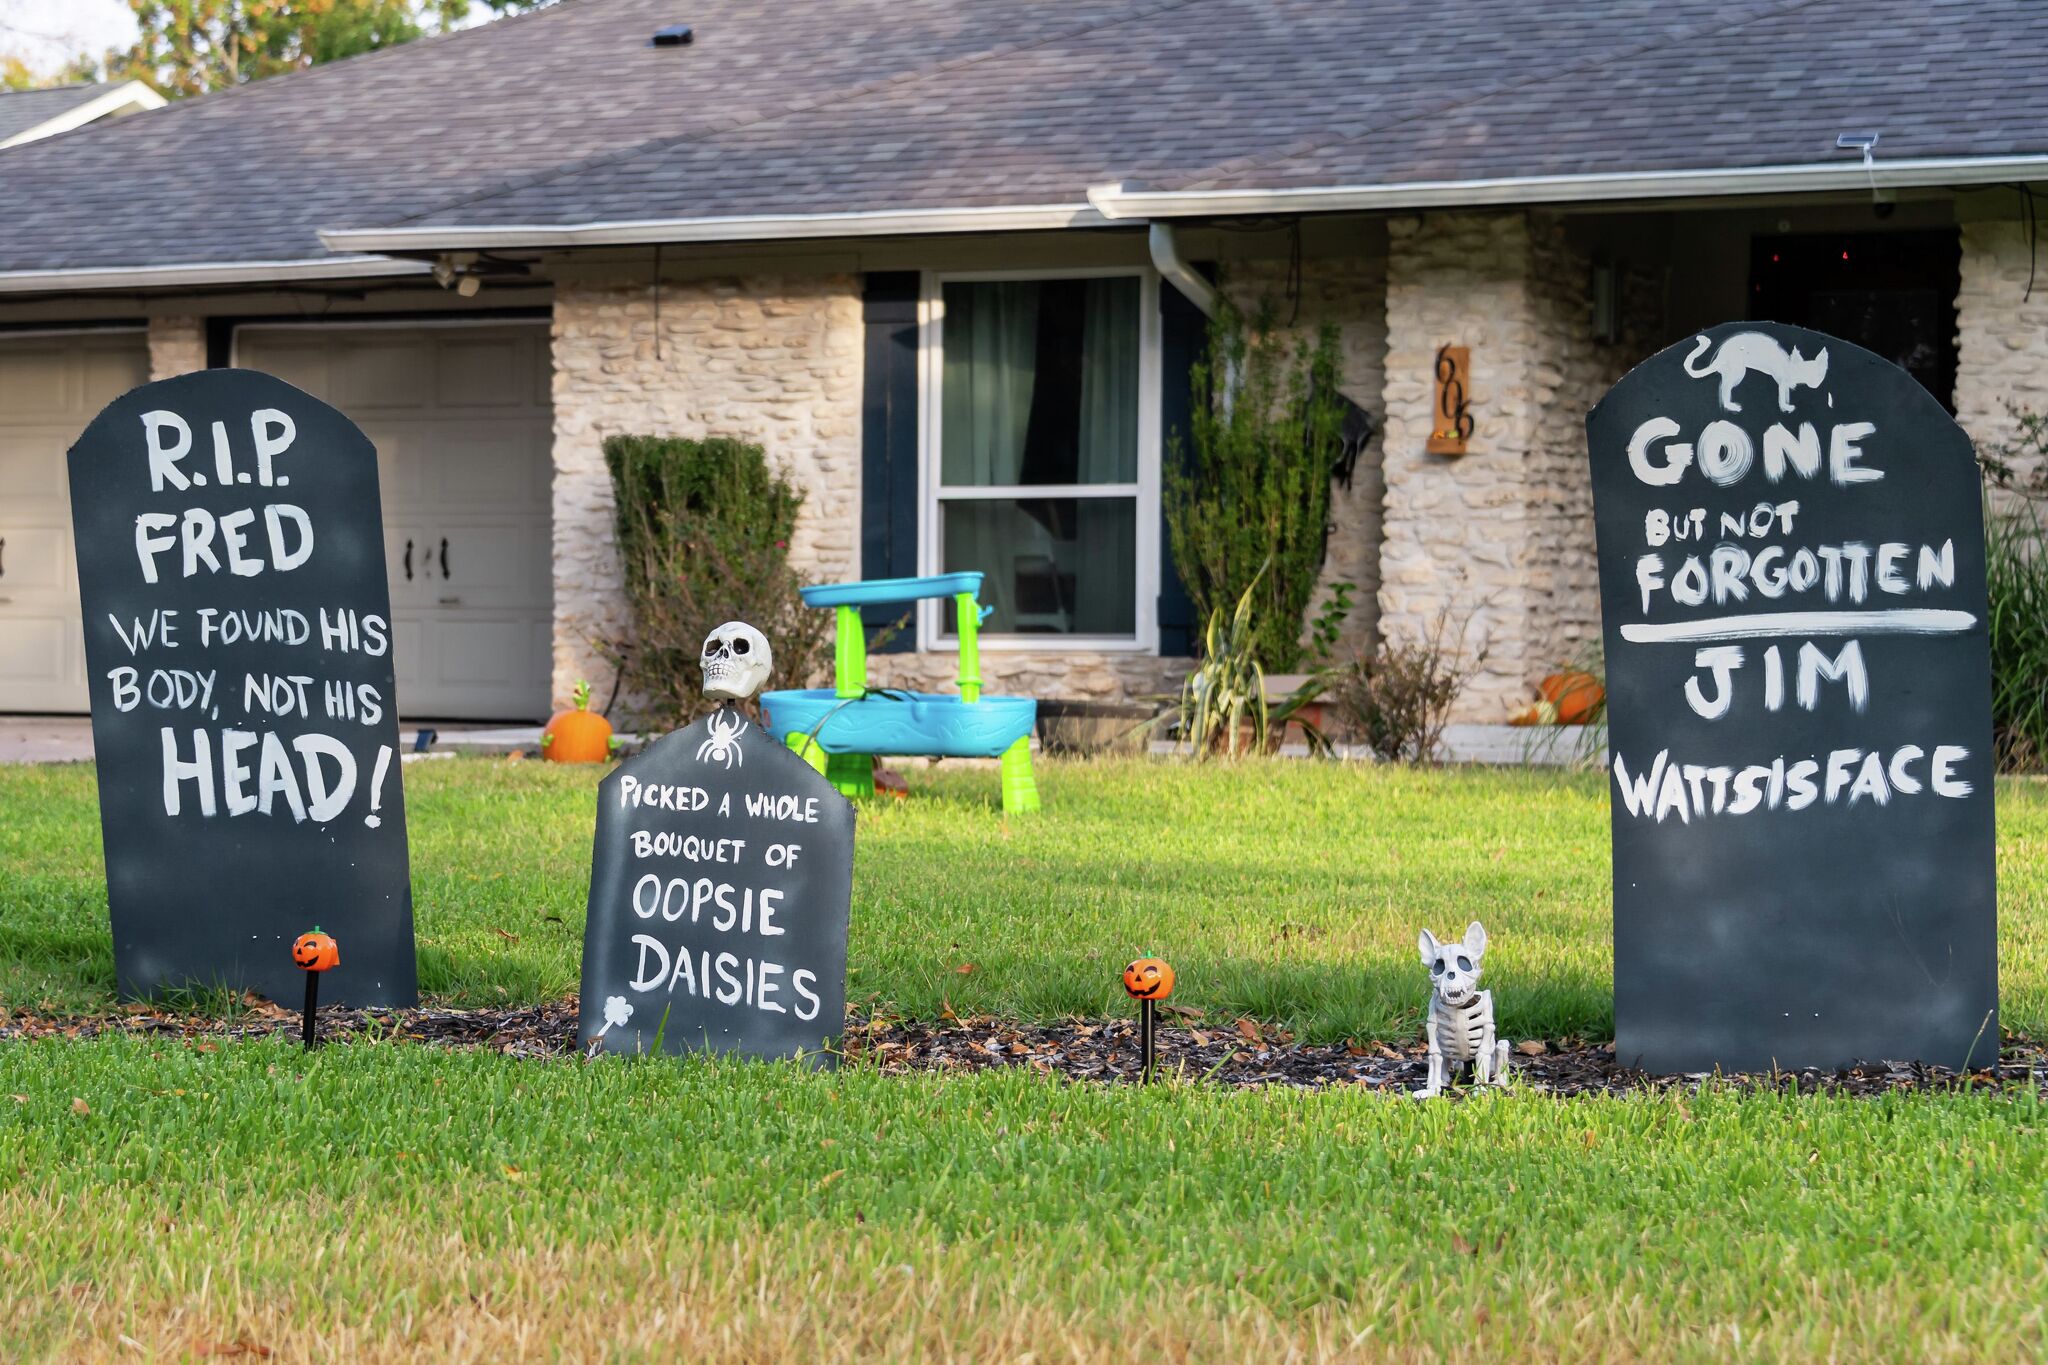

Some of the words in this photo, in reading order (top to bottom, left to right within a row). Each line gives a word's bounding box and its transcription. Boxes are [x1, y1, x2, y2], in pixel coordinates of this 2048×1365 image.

[1435, 342, 1475, 441] 606
[140, 408, 297, 492] R.I.P.
[1627, 416, 1886, 488] GONE
[135, 503, 315, 584] FRED
[1645, 508, 1707, 547] BUT
[1720, 500, 1800, 540] NOT
[1635, 538, 1956, 615] FORGOTTEN
[108, 607, 180, 656] WE
[196, 607, 310, 648] FOUND
[320, 607, 388, 657] HIS
[107, 666, 219, 720] BODY,
[244, 673, 314, 719] NOT
[325, 679, 383, 726] HIS
[1684, 639, 1868, 720] JIM
[161, 726, 393, 829] HEAD!
[619, 774, 710, 812] PICKED
[717, 791, 731, 818] A
[744, 792, 820, 824] WHOLE
[1613, 744, 1975, 825] WATTSISFACE
[629, 830, 746, 864] BOUQUET
[765, 844, 802, 870] OF
[632, 873, 786, 936] OOPSIE
[628, 934, 821, 1021] DAISIES
